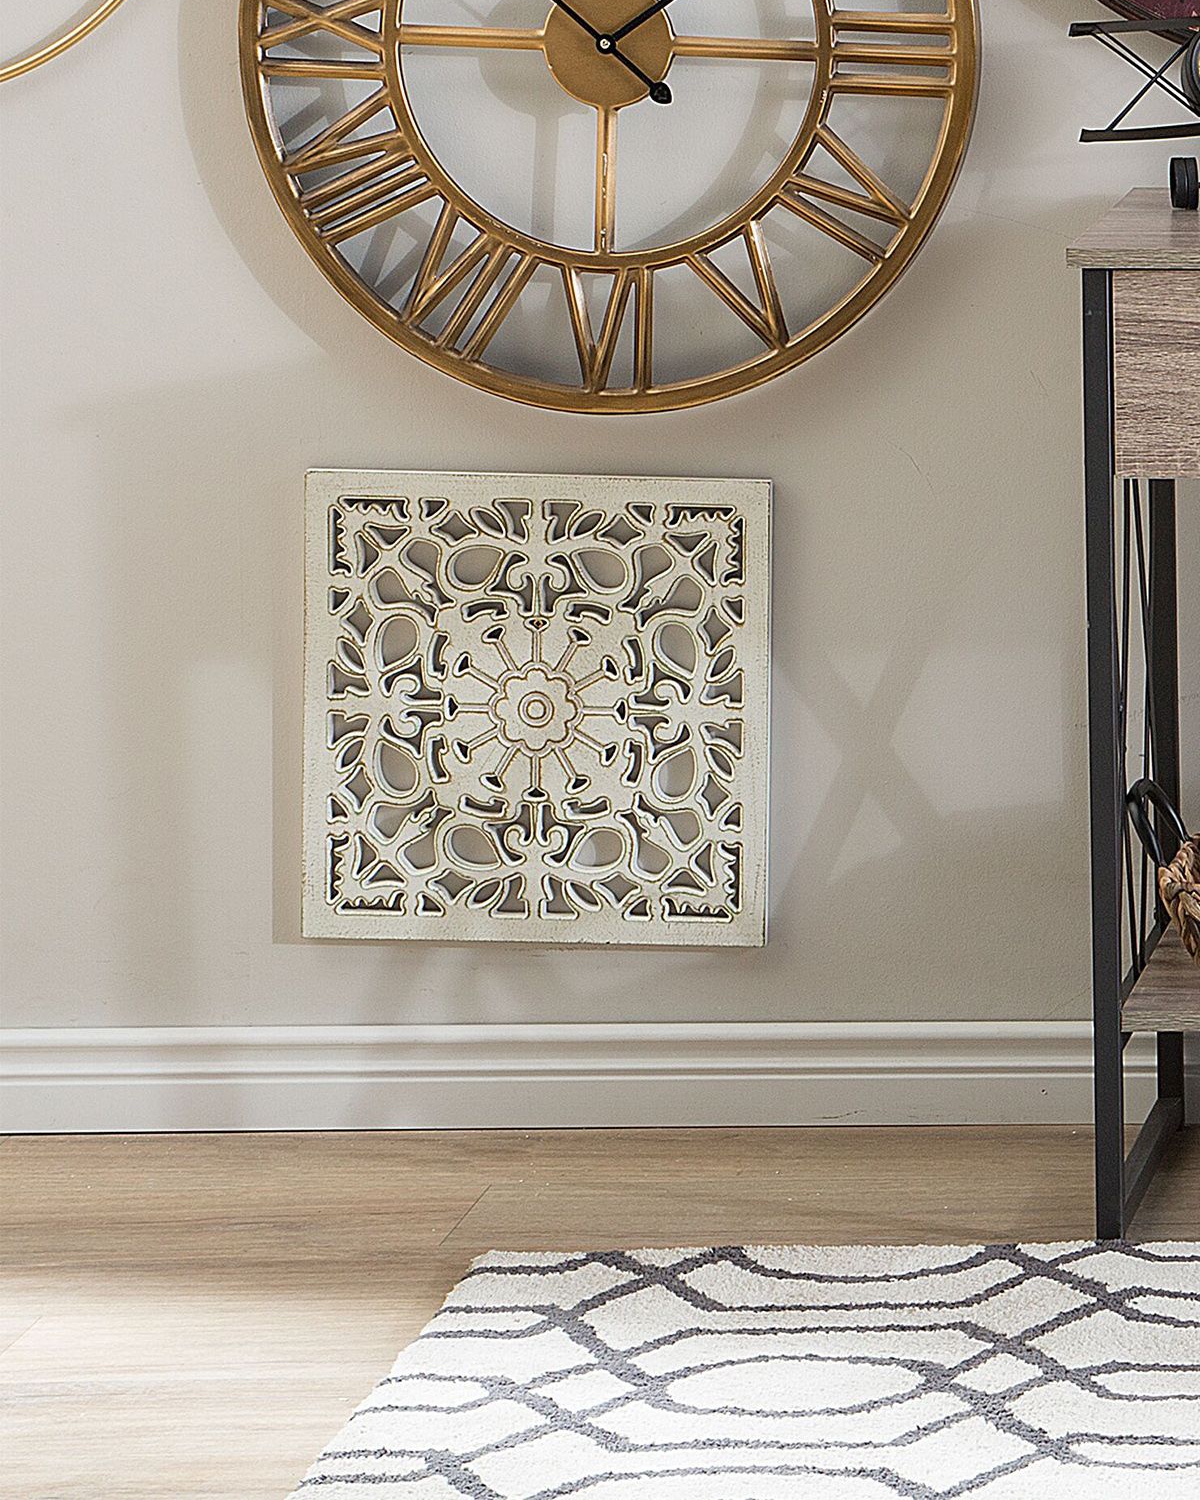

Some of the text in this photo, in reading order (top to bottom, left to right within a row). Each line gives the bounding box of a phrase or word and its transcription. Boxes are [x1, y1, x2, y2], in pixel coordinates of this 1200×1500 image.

[830, 10, 957, 99] III
[284, 85, 440, 245] VIII
[777, 124, 913, 263] IV
[400, 200, 541, 363] VII
[563, 266, 652, 396] VI
[690, 219, 789, 351] V
